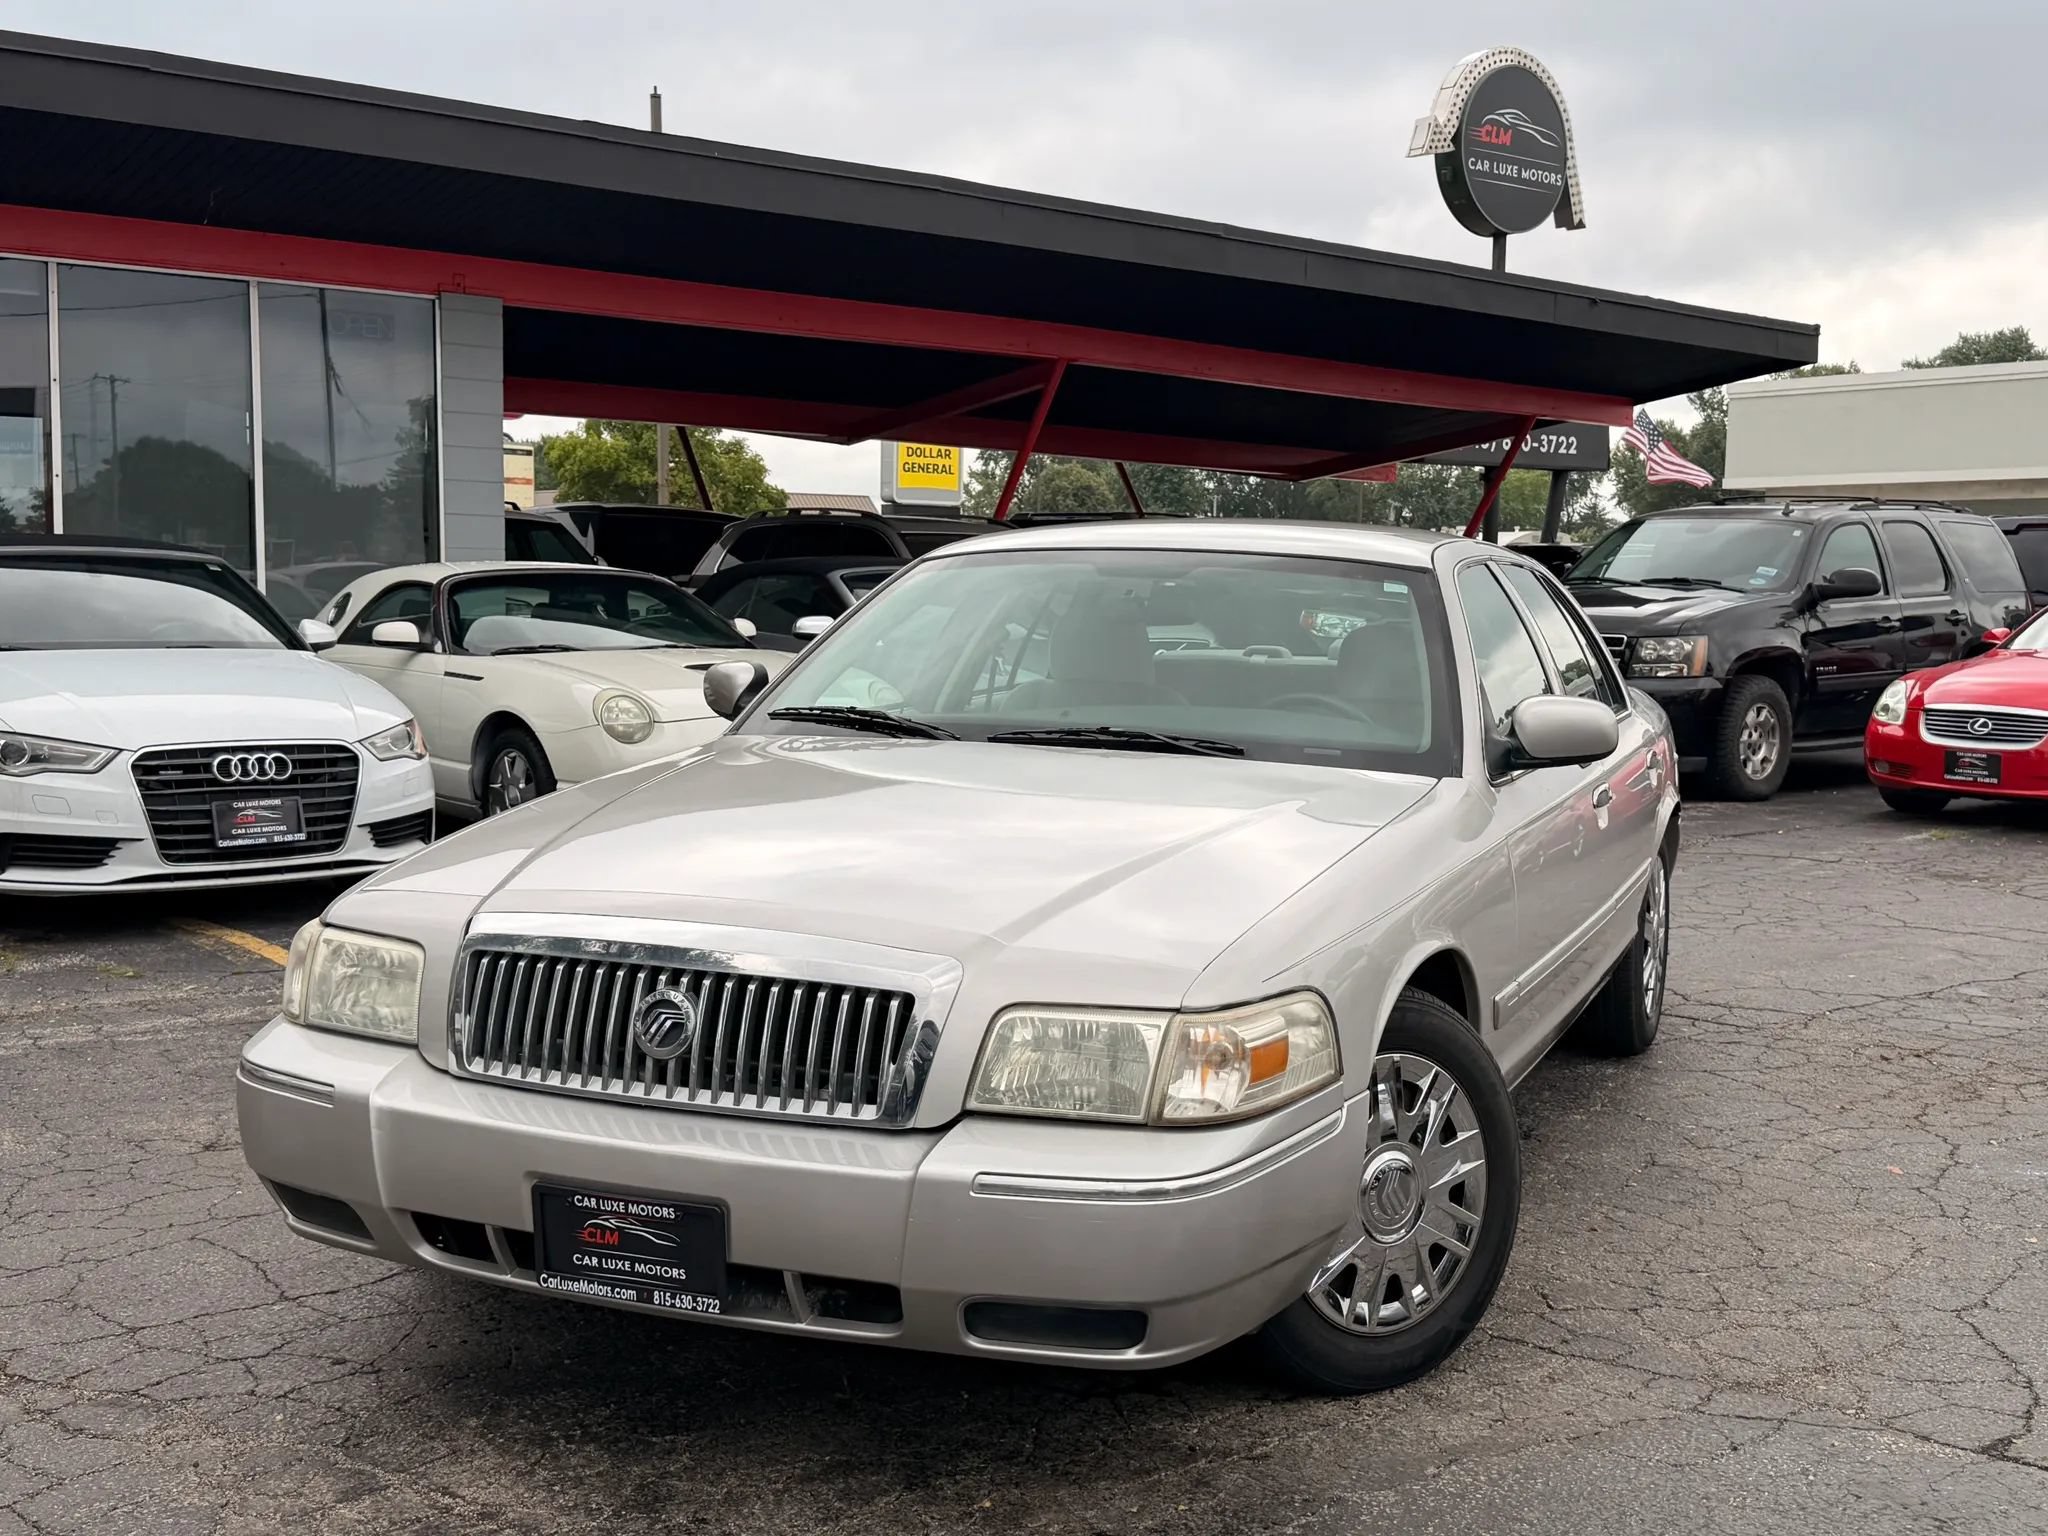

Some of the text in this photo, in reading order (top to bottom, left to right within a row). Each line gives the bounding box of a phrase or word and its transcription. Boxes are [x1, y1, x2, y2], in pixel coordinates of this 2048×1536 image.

[1481, 124, 1513, 146] CLM
[1468, 157, 1562, 186] CAR LUXE MOTORS
[906, 446, 952, 460] DOLLAR
[902, 461, 955, 475] GENERAL
[232, 827, 246, 835] CAR
[574, 1195, 676, 1219] CAR LUXE MOTORS
[584, 1227, 619, 1245] CLM
[573, 1253, 687, 1280] CAR LUXE MOTORS
[539, 1273, 720, 1314] CarLuxeMotors.com 815-630-3722
